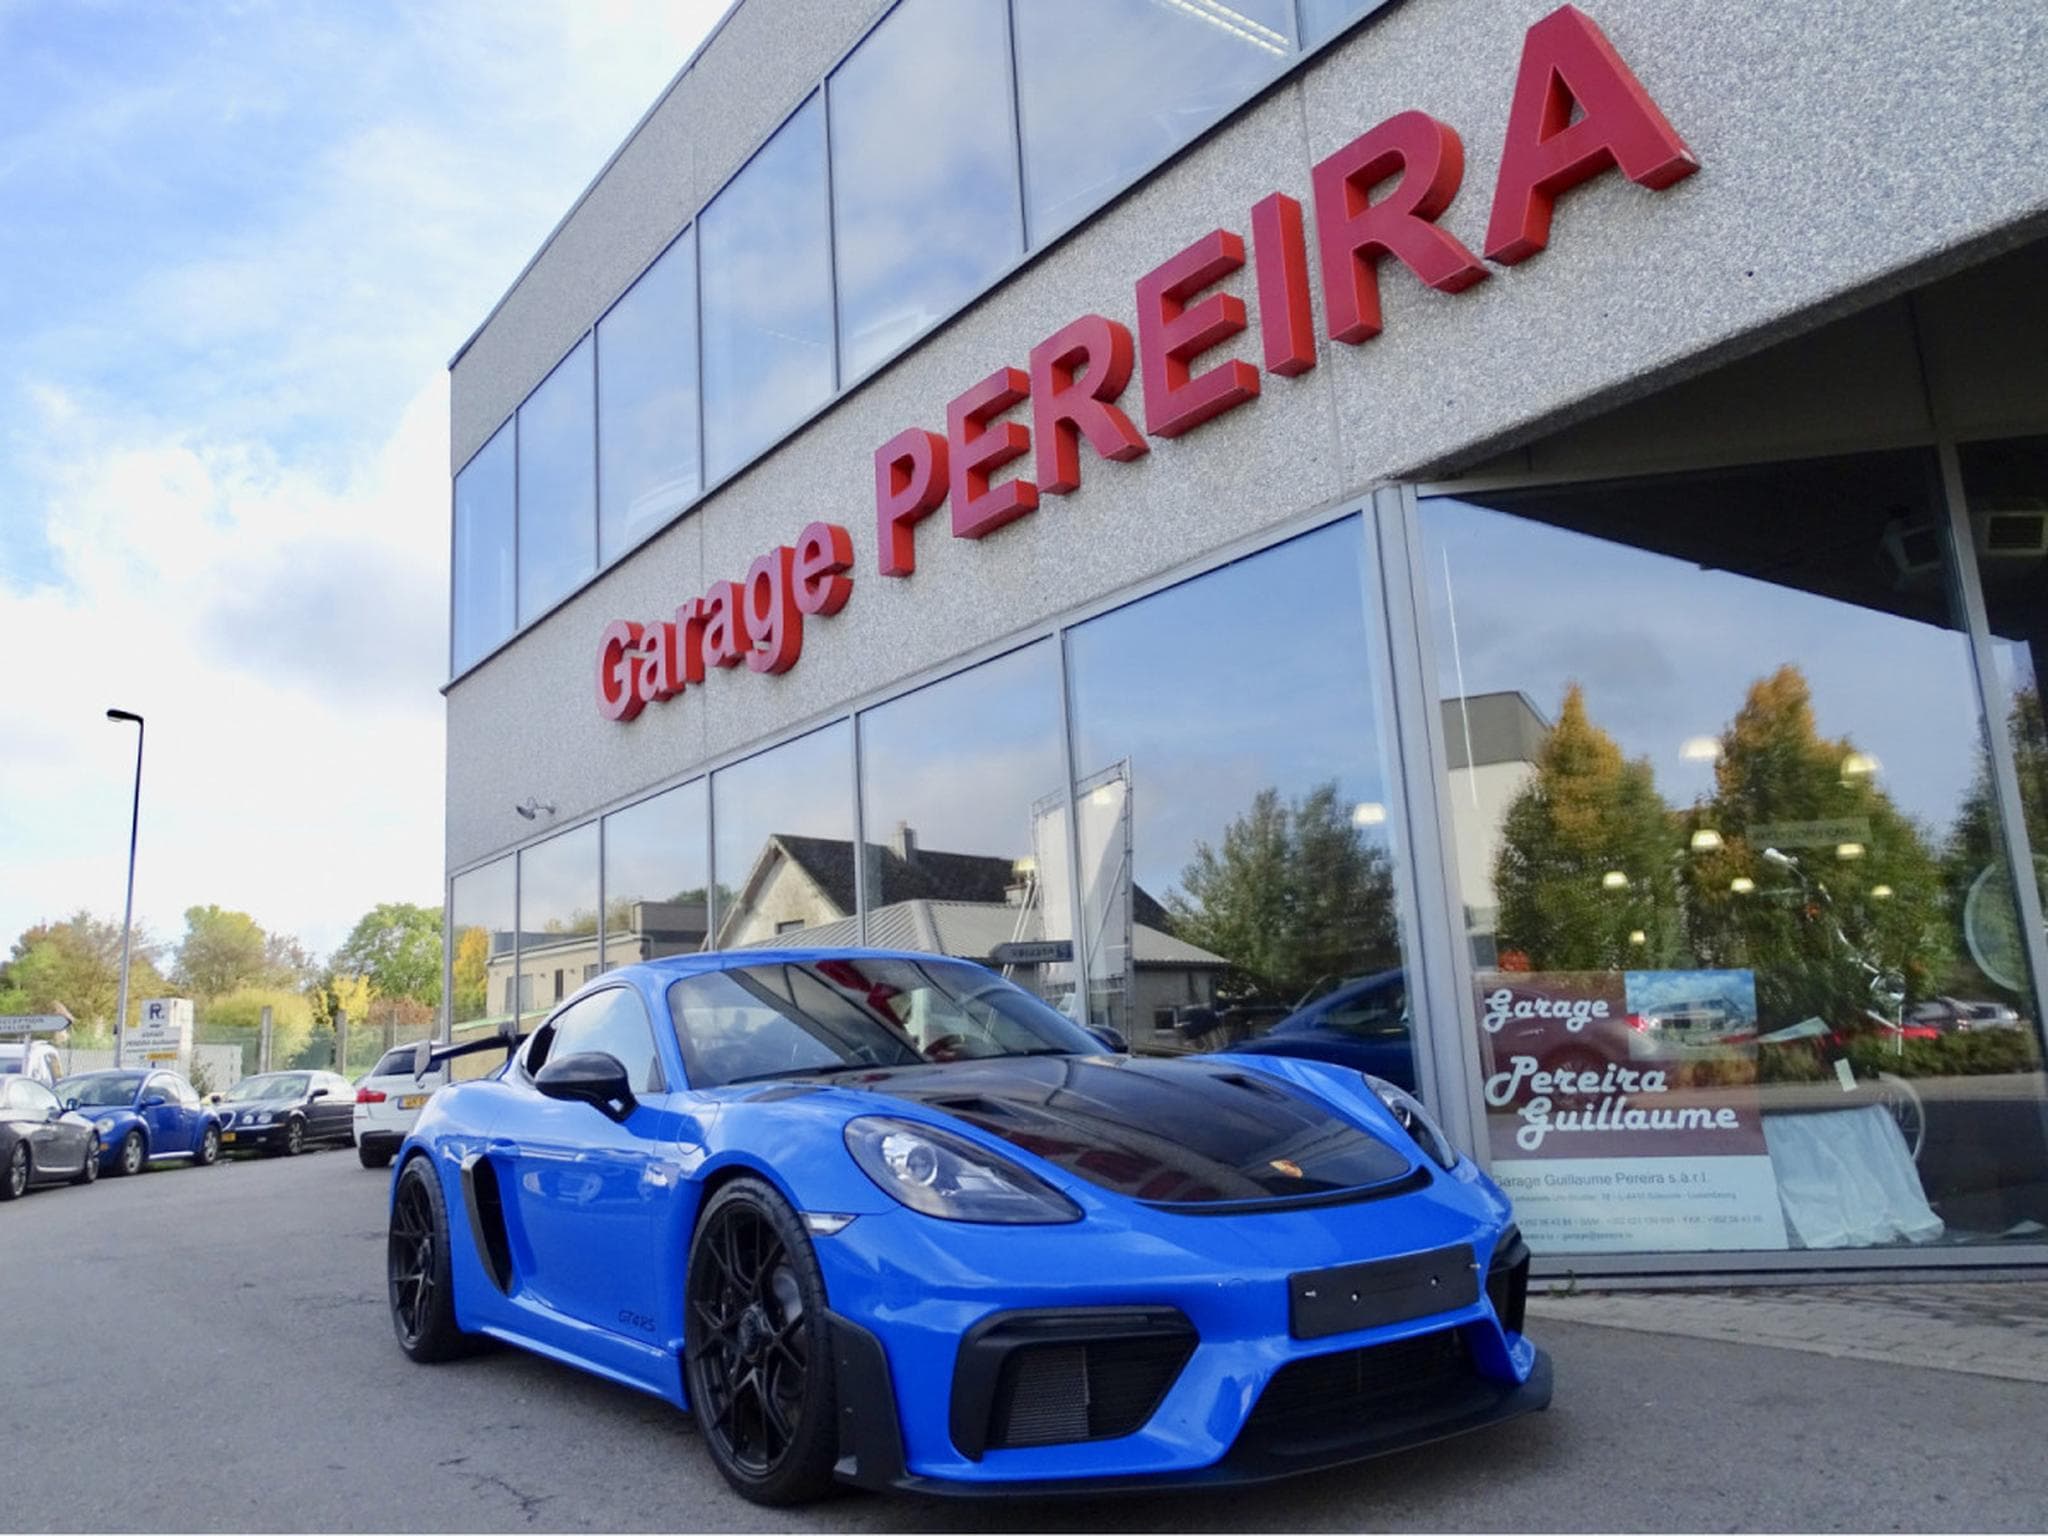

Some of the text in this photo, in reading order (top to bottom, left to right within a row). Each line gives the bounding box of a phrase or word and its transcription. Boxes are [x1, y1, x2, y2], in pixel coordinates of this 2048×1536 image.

[596, 3, 1701, 722] Garage PEREIRA
[1482, 988, 1610, 1033] Garage
[1484, 1055, 1668, 1106] Pereira
[1516, 1096, 1739, 1150] Guillaume
[1544, 1174, 1612, 1186] Guillaume
[1615, 1171, 1665, 1185] Pereira
